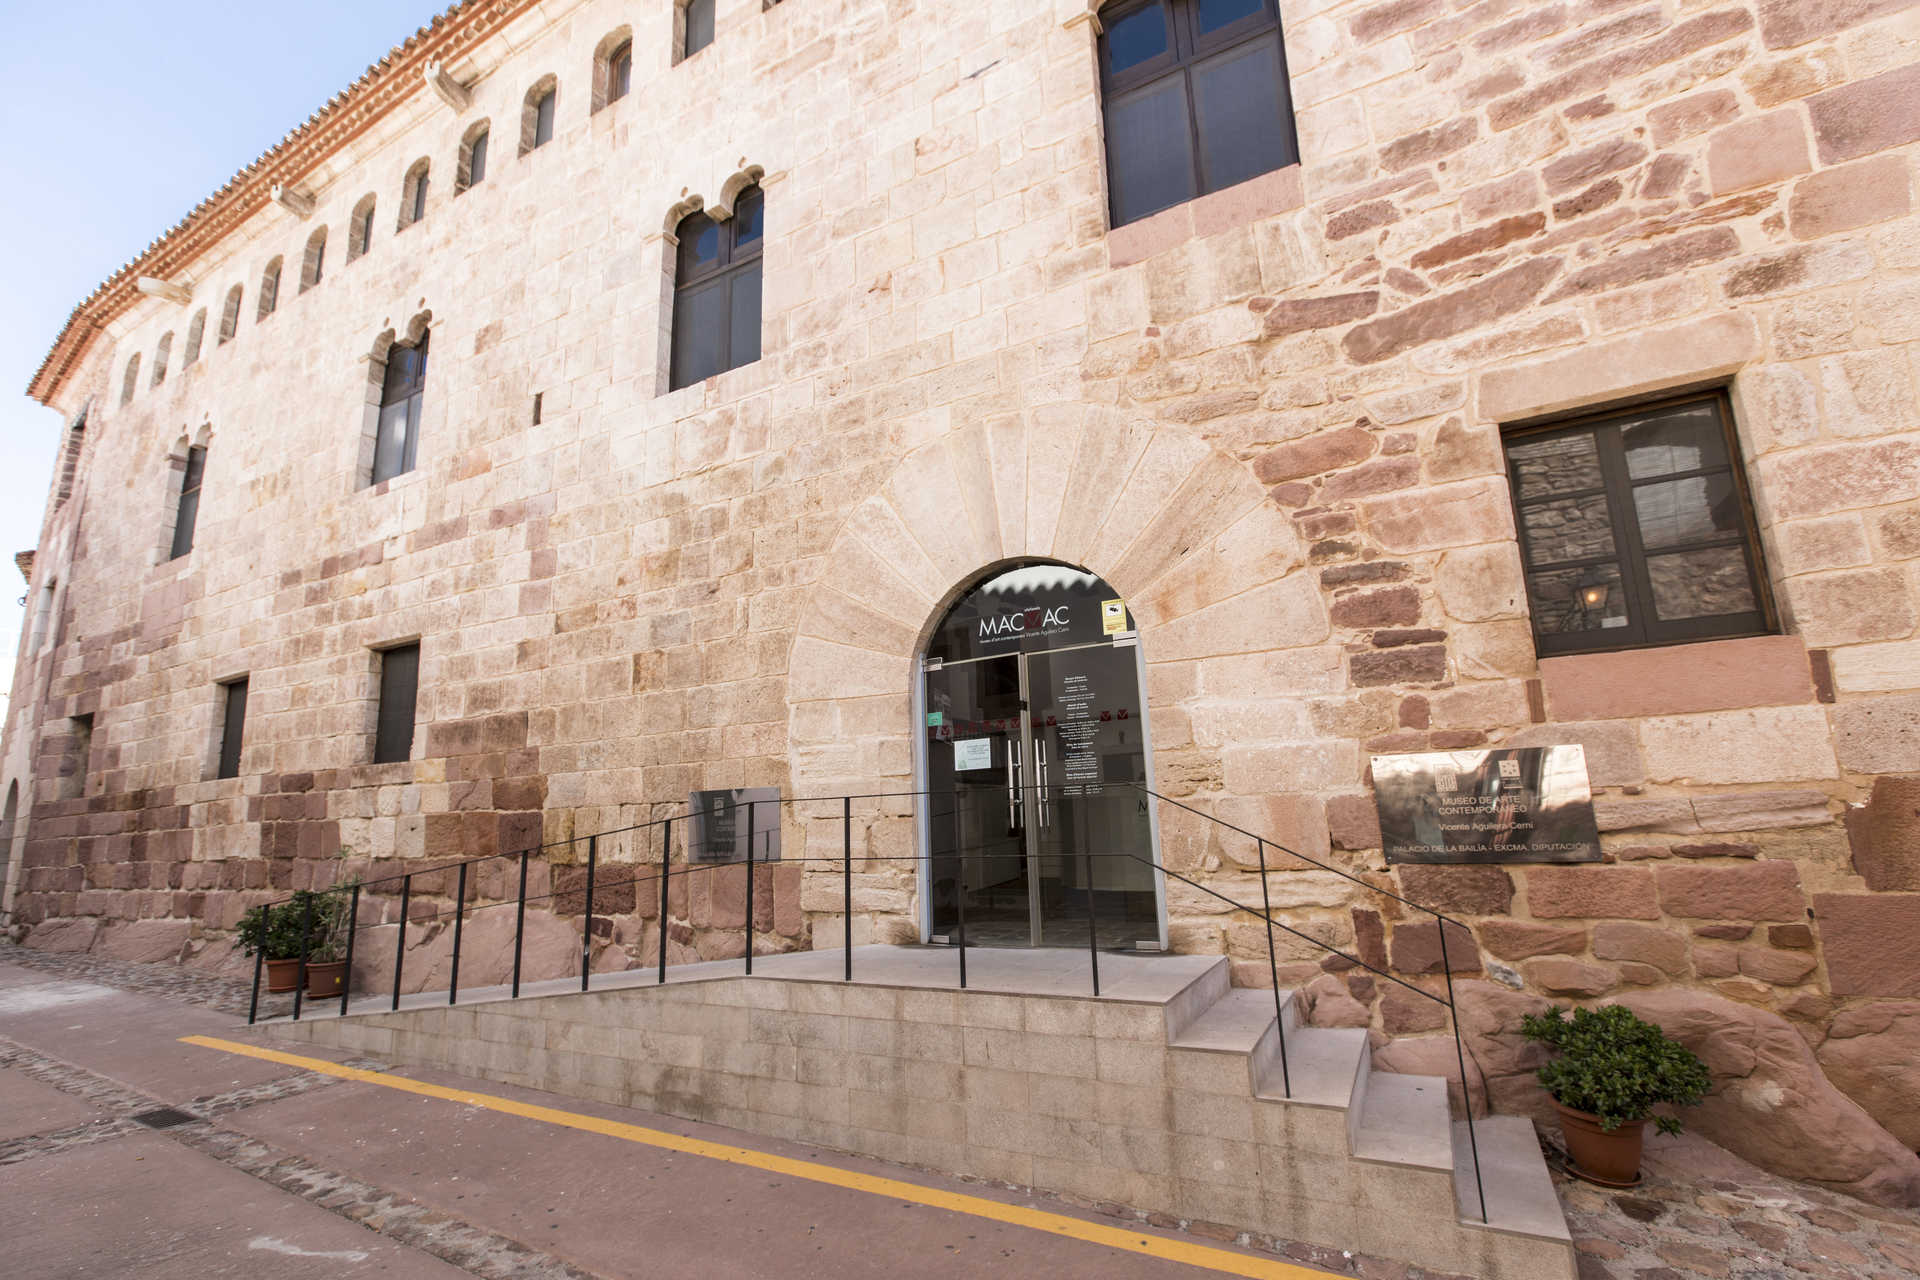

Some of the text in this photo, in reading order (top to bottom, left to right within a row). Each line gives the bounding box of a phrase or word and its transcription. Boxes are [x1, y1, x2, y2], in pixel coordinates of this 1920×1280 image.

[1442, 796, 1521, 806] MUSEO DE ARTE
[1438, 823, 1470, 831] Vicente
[1393, 845, 1430, 853] PALACIO
[1431, 845, 1445, 853] DE
[1446, 844, 1457, 853] LA
